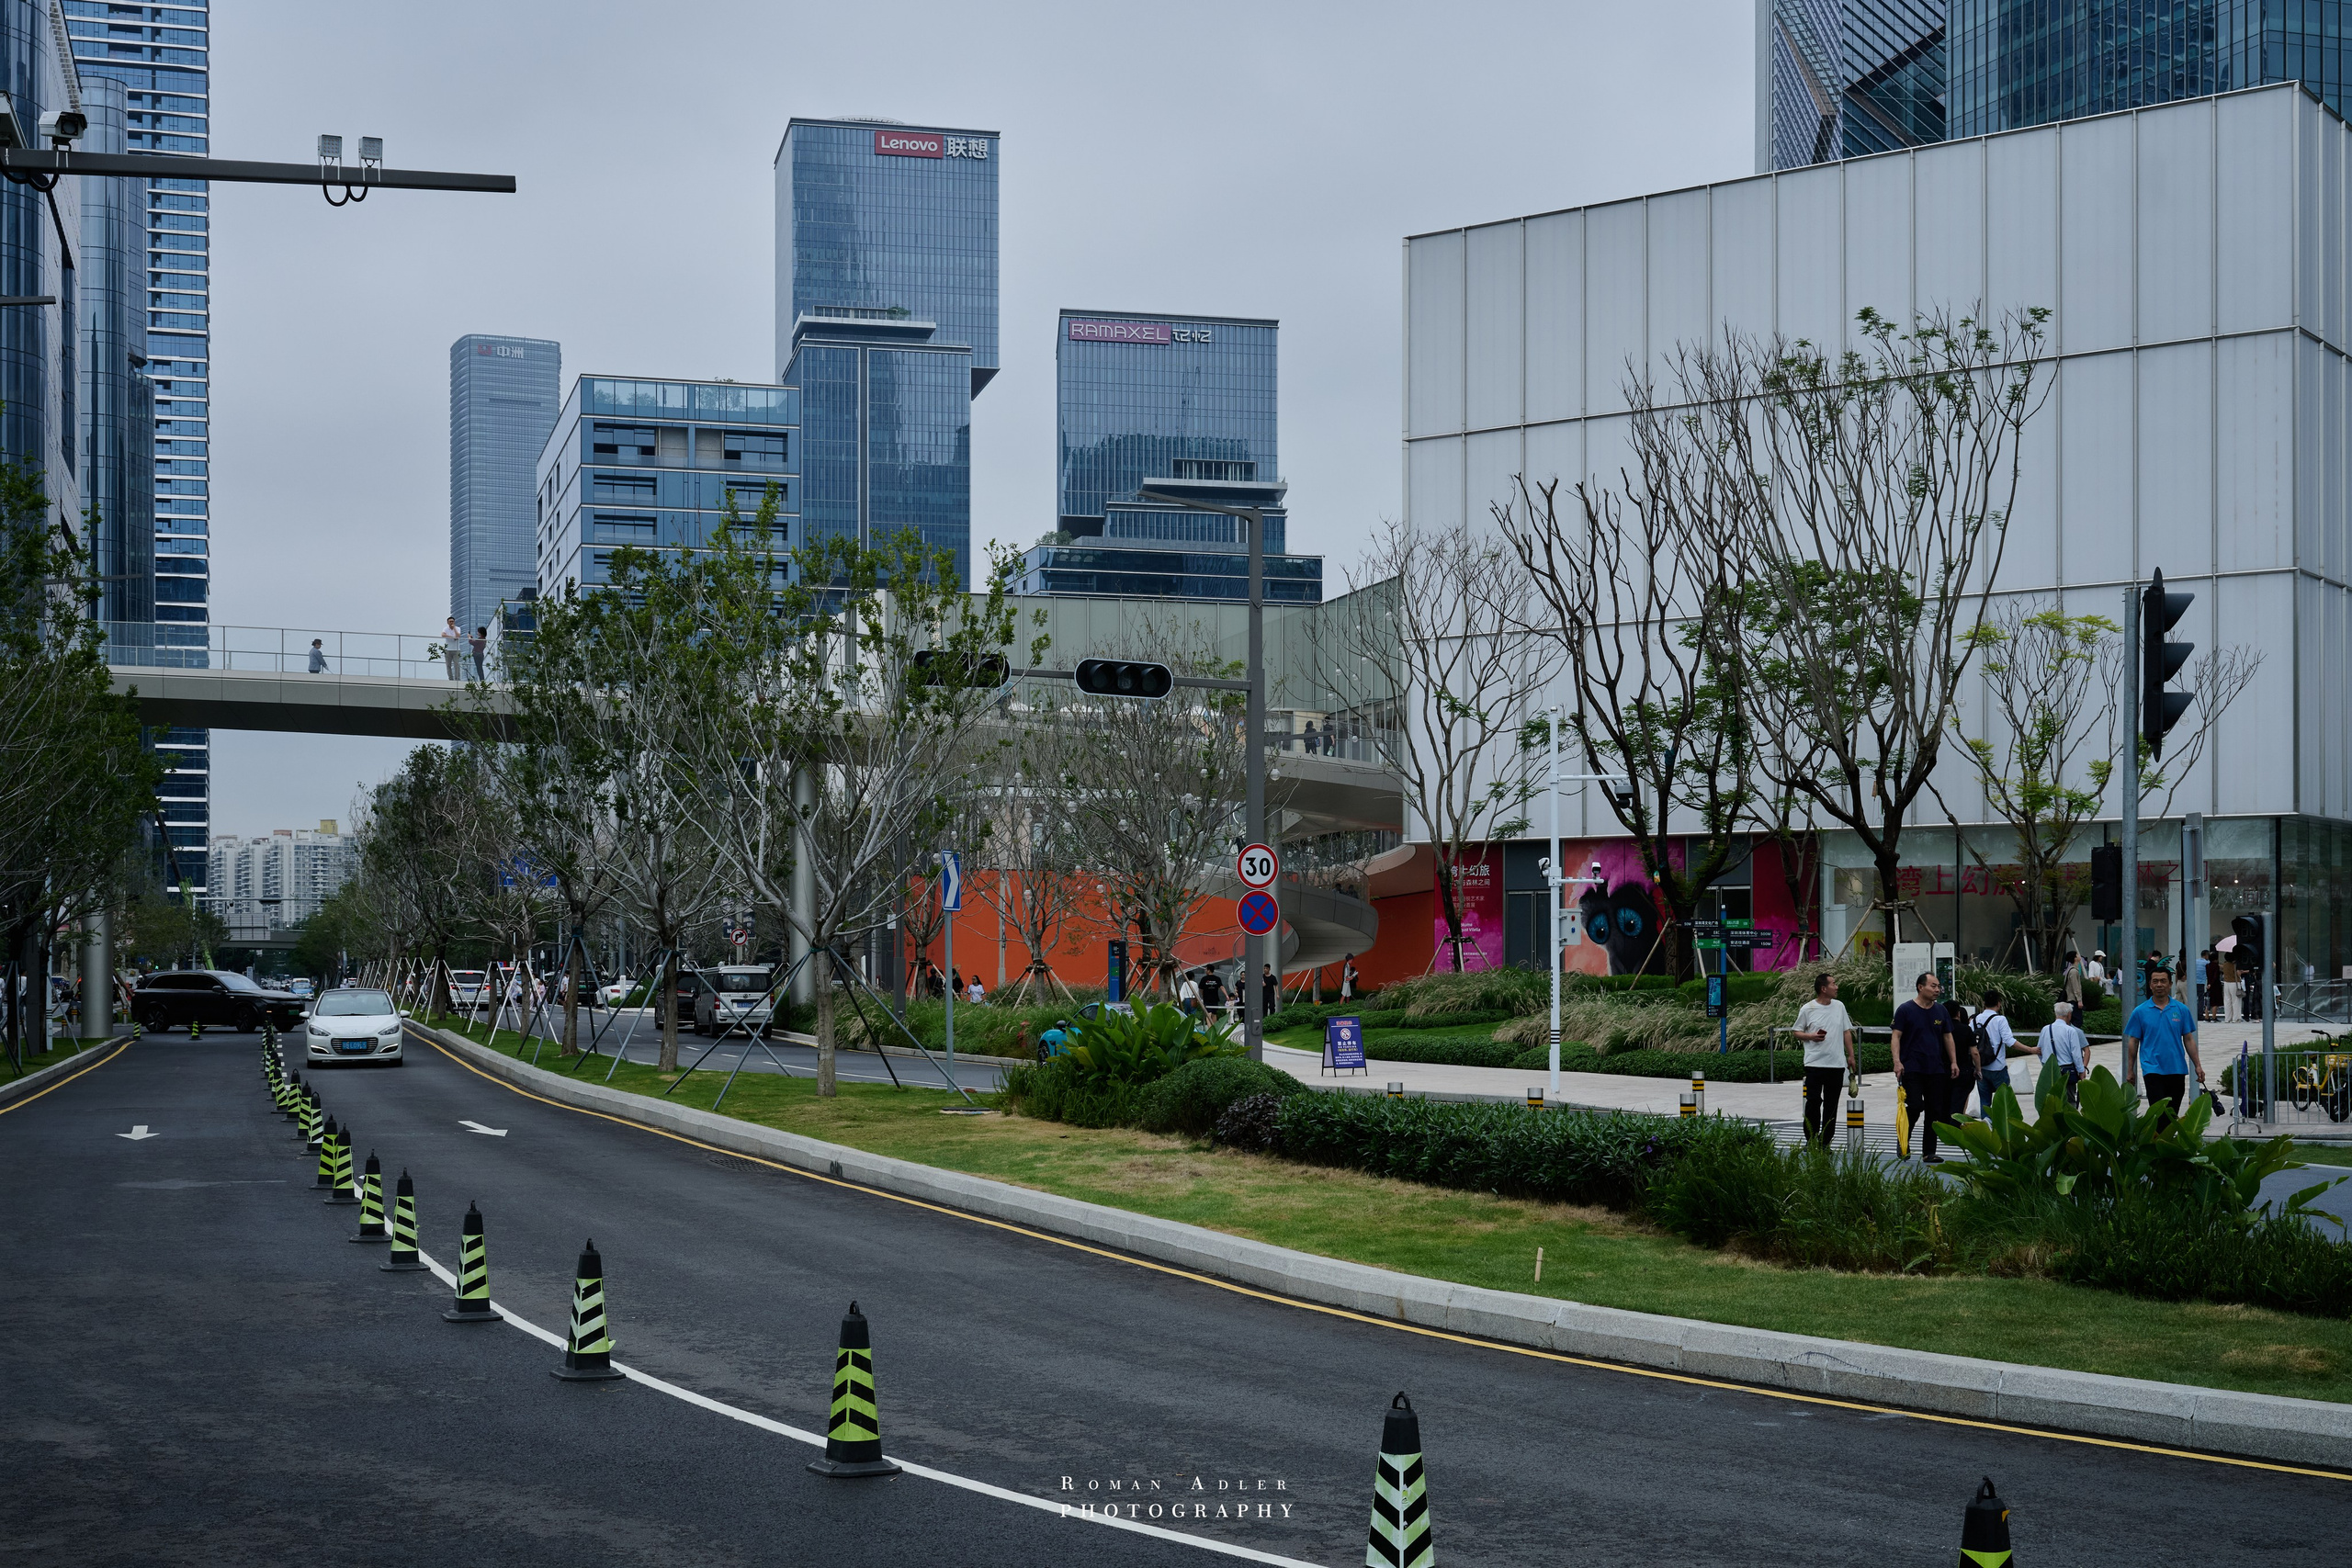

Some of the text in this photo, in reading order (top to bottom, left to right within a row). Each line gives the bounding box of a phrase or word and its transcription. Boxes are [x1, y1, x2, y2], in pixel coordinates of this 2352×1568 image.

[881, 135, 938, 152] Lenovo
[946, 137, 988, 159] 联想
[1071, 323, 1169, 341] RAMAXEL
[496, 345, 524, 359] 中洲
[1245, 857, 1271, 876] 30
